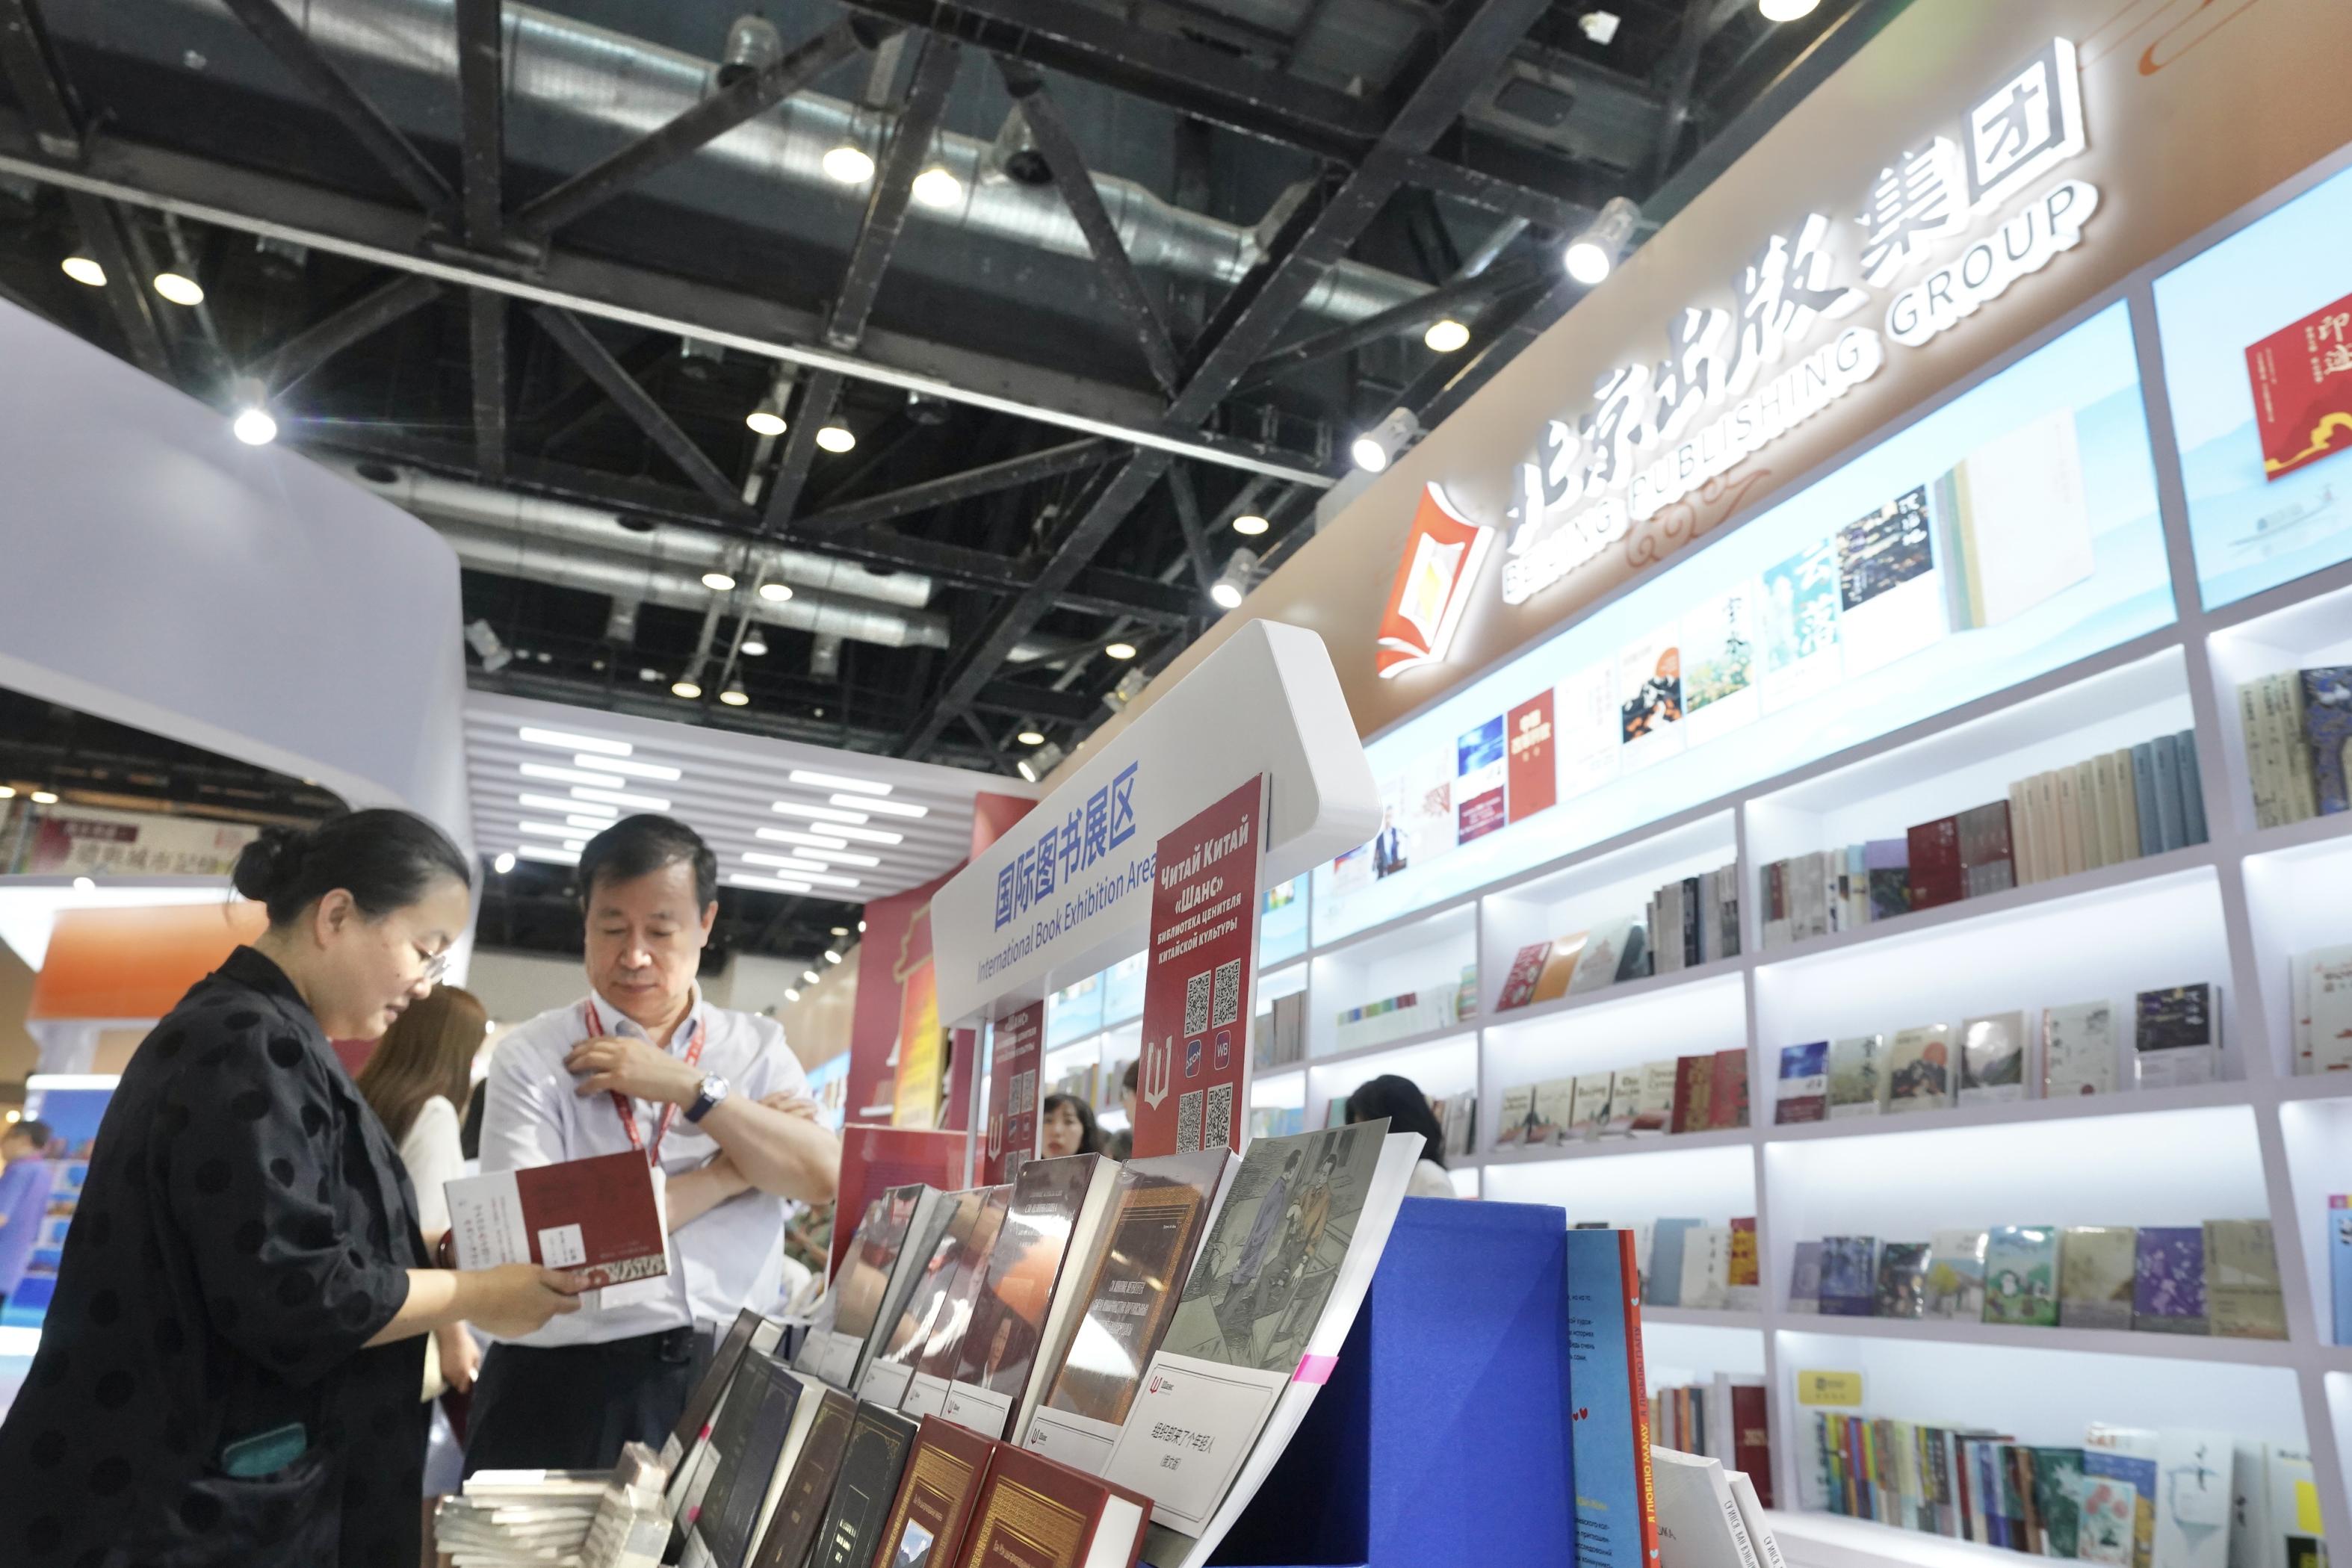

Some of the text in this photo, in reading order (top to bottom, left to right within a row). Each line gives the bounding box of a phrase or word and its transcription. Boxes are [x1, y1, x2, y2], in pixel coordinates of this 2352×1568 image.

[1505, 36, 2085, 557] 北京出版集团
[1629, 329, 1874, 517] PUBLISHING
[1887, 182, 2089, 341] GROUP
[994, 760, 1139, 933] 国际图书展区
[1161, 814, 1248, 890] ЧИТАЙ КИТАЙ
[977, 851, 1157, 985] International Book Exhibition Area
[1157, 893, 1242, 945] БИБЛИОТЕКА ЦЕНИТЕЛЯ
[1175, 876, 1224, 914] «ШАНС»
[1158, 917, 1238, 964] КИТАЙСКОЙ КУЛЬТУРЫ
[1217, 1042, 1228, 1057] WB
[1634, 1325, 1643, 1360] ПАПУ
[1636, 1361, 1646, 1407] ЛЮБЛЮ
[1644, 1465, 1655, 1513] ЛЮБЛЮ
[1736, 1531, 1747, 1546] ВАН
